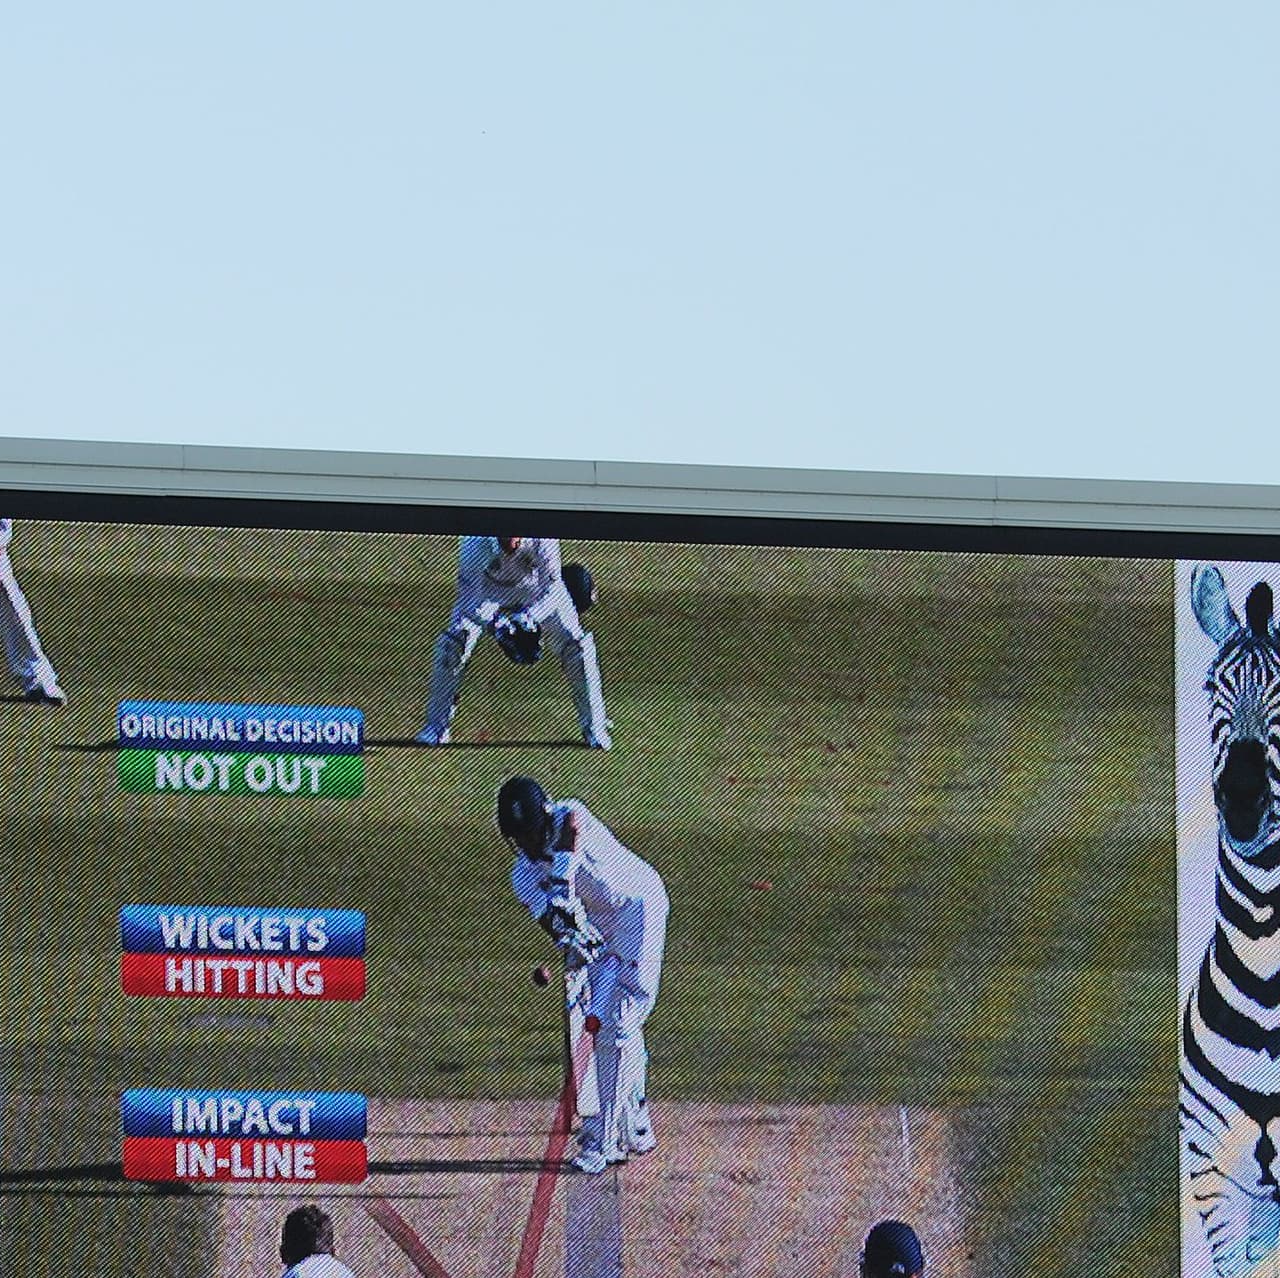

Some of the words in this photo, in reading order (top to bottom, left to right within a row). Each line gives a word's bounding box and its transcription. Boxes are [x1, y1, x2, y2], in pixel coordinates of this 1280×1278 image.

[121, 713, 241, 743] ORIGINAL
[245, 718, 359, 746] DECISION
[155, 754, 232, 793] NOT
[243, 756, 326, 795] OUT
[159, 912, 329, 952] WICKETS
[164, 957, 324, 997] HITTING
[172, 1097, 318, 1136] IMPACT
[175, 1141, 317, 1179] IN-LINE
